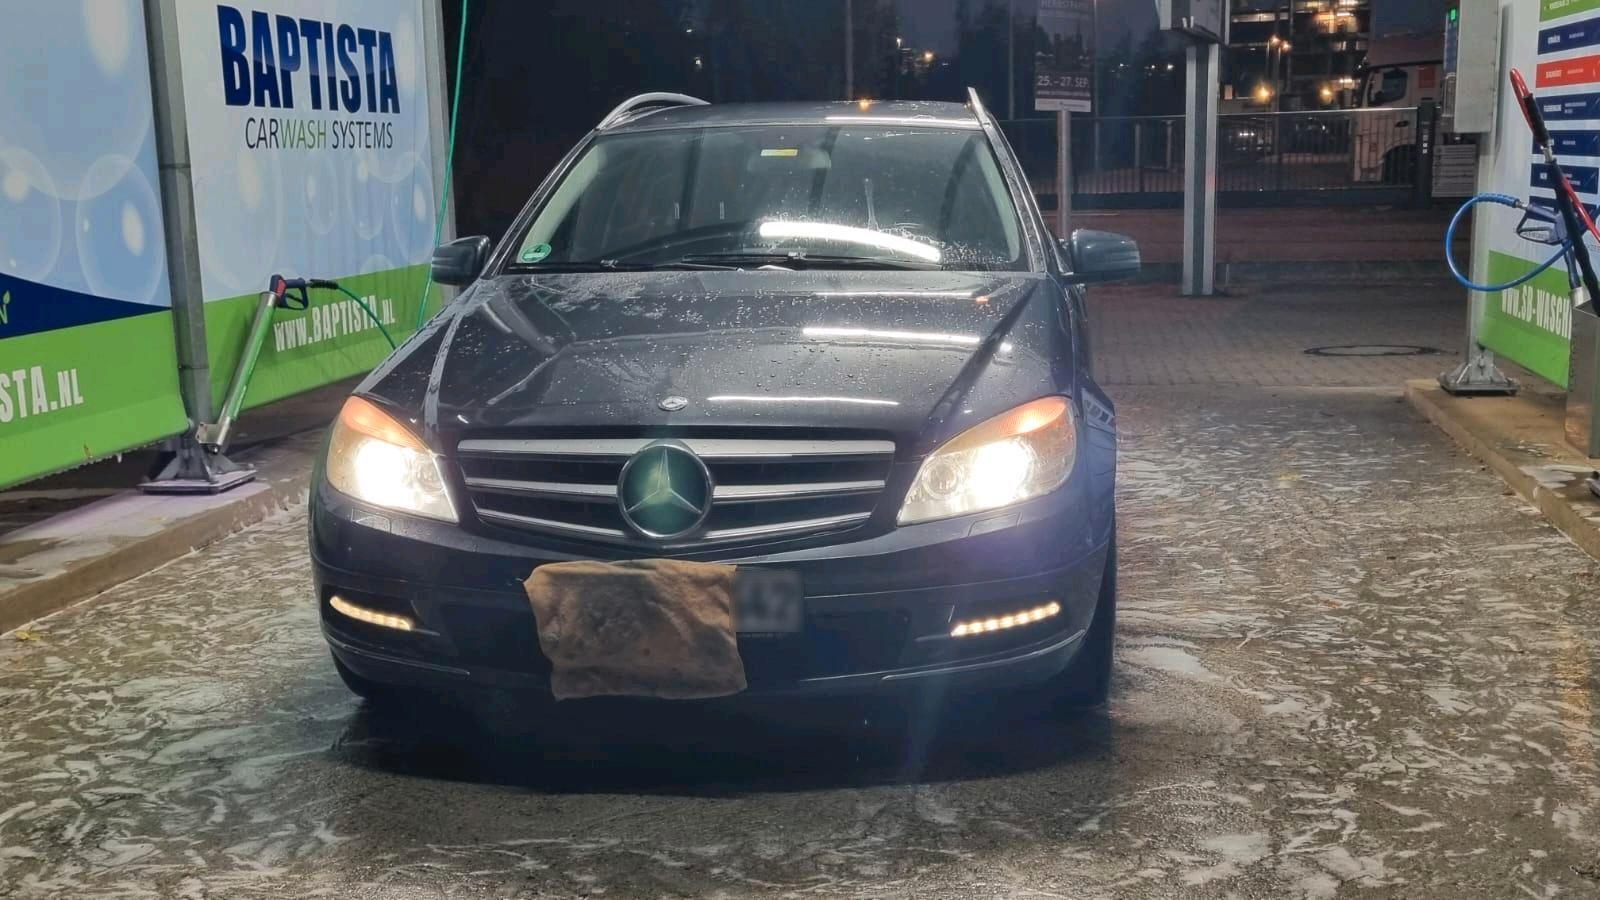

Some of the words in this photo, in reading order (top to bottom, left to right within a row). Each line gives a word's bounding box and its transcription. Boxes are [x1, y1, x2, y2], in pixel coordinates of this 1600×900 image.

[217, 5, 400, 114] BAPTISTA
[245, 117, 327, 149] CARWASH
[332, 120, 393, 149] SYSTEMS
[274, 295, 395, 352] WWW.BAPTISTA.NL
